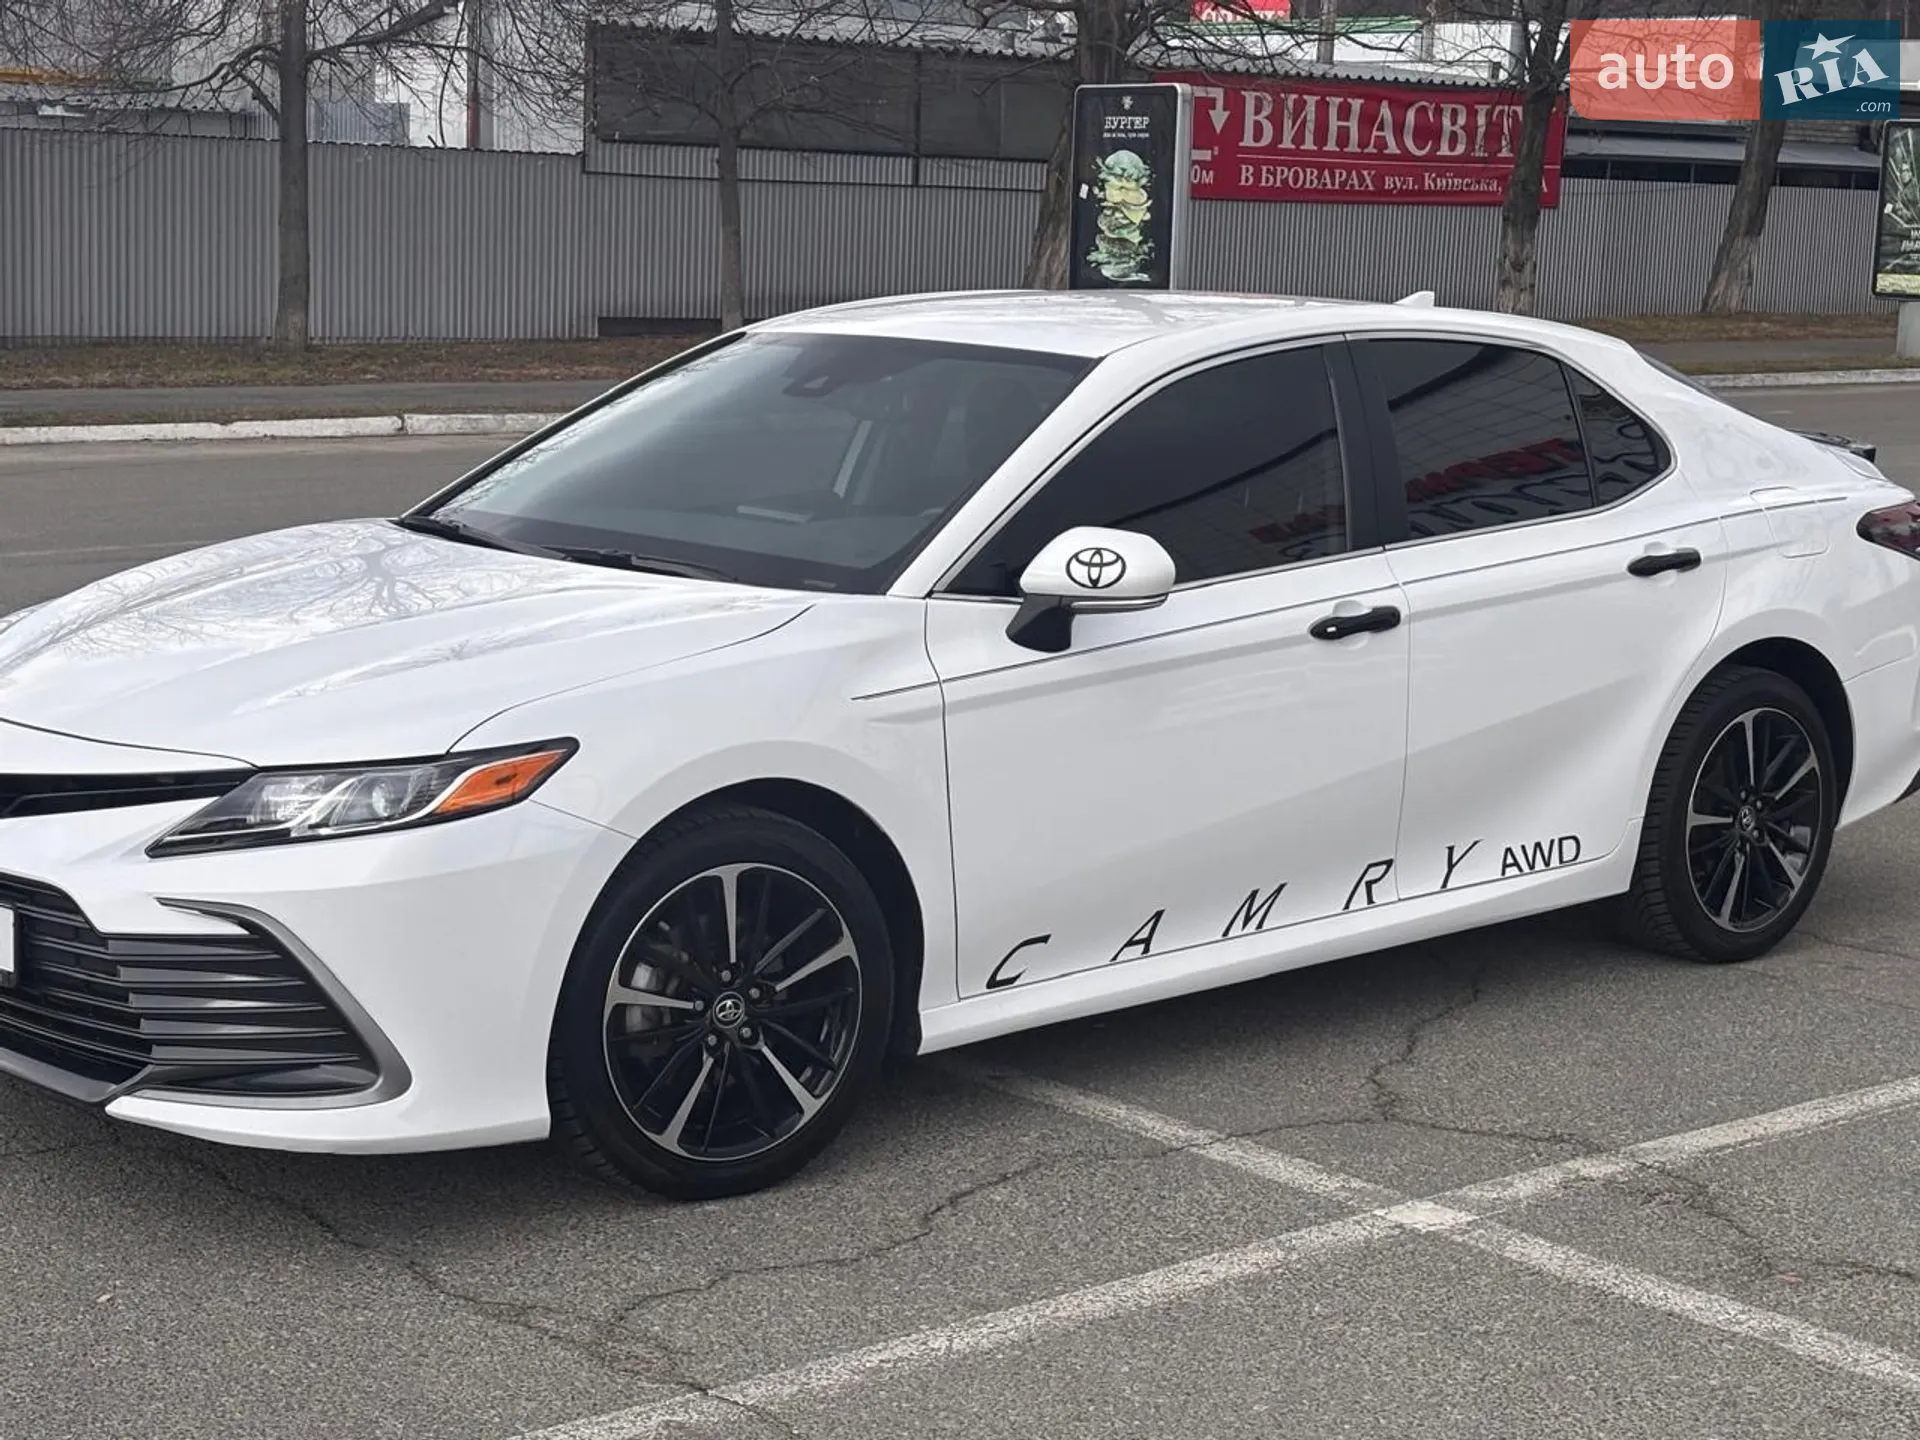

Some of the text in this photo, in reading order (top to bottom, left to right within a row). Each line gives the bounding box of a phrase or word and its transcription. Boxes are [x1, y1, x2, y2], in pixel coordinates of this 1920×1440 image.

[1104, 116, 1150, 130] БУРГЕР
[1238, 90, 1557, 158] ВИНАСВІТ
[1238, 164, 1254, 186] В
[1259, 165, 1376, 191] БРОВАРАХ
[1384, 175, 1418, 194] вул.
[985, 834, 1582, 990] CAMRY AWD
